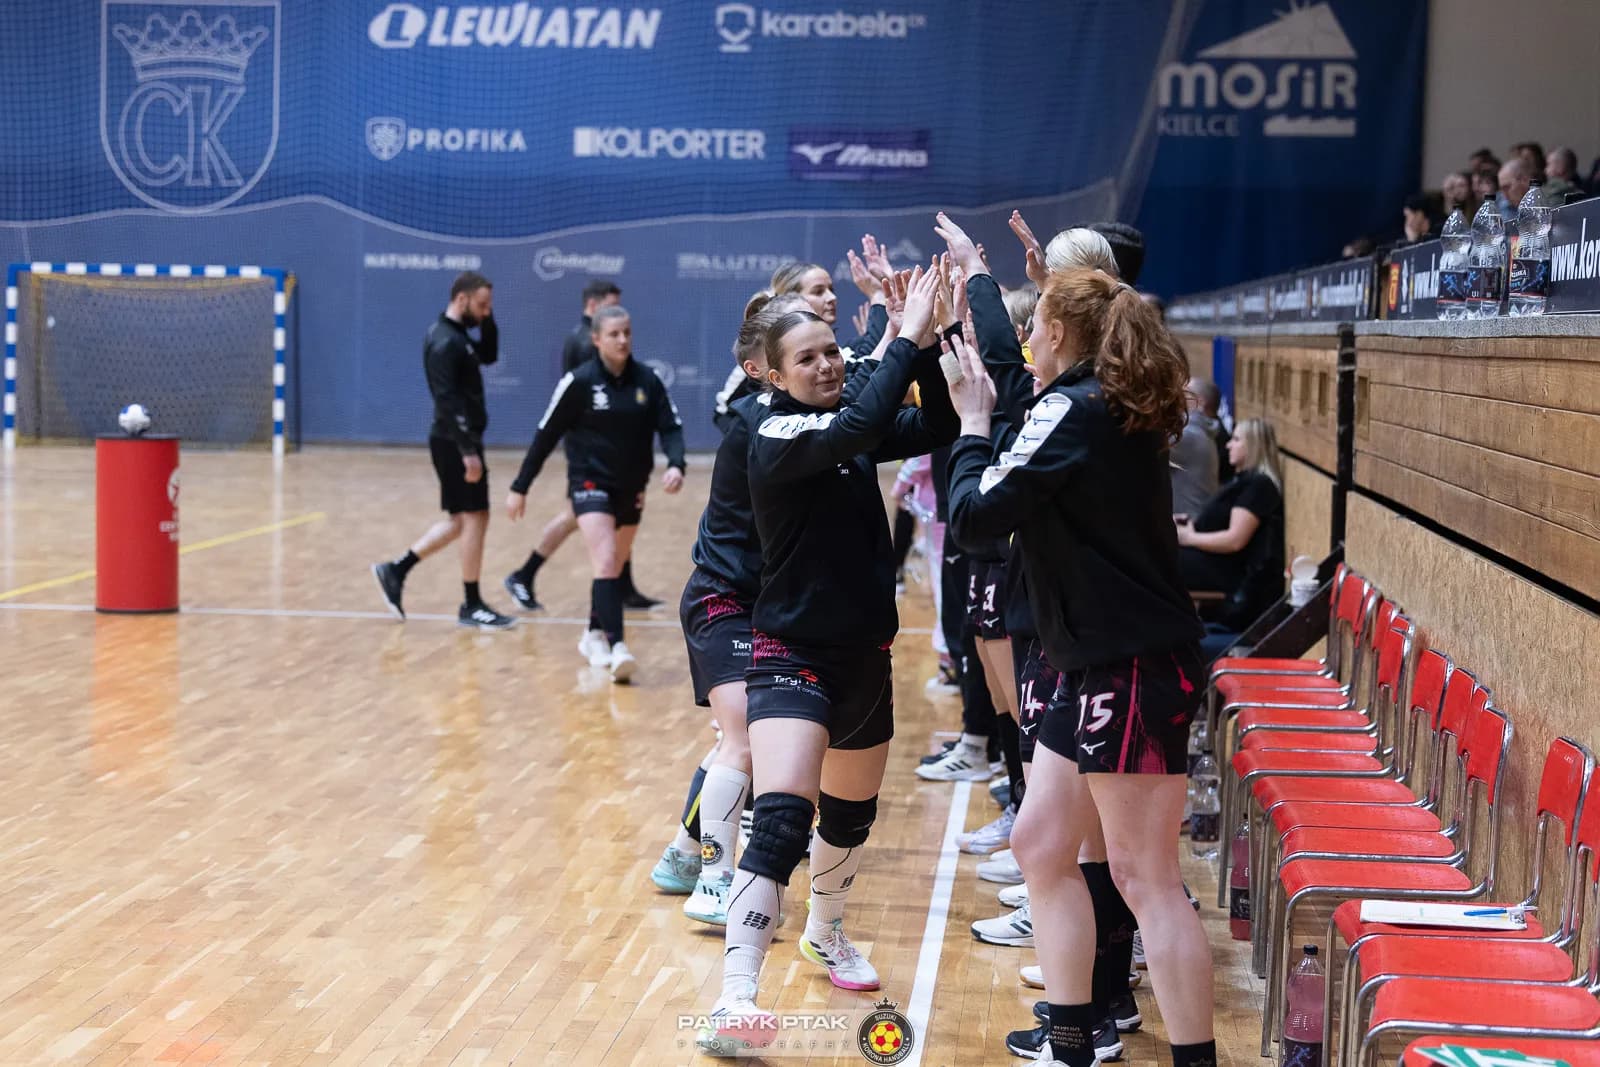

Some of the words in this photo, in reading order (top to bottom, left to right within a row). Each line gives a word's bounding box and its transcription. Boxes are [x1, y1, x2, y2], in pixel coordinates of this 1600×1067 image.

[428, 3, 661, 48] LEWIATAN
[762, 9, 907, 37] karabela
[119, 81, 246, 187] CK
[407, 128, 527, 152] PROFIKA
[1157, 113, 1240, 137] KIELCE
[596, 128, 766, 160] KOLPORTER
[1551, 218, 1600, 282] www.kor
[1078, 692, 1115, 733] 15
